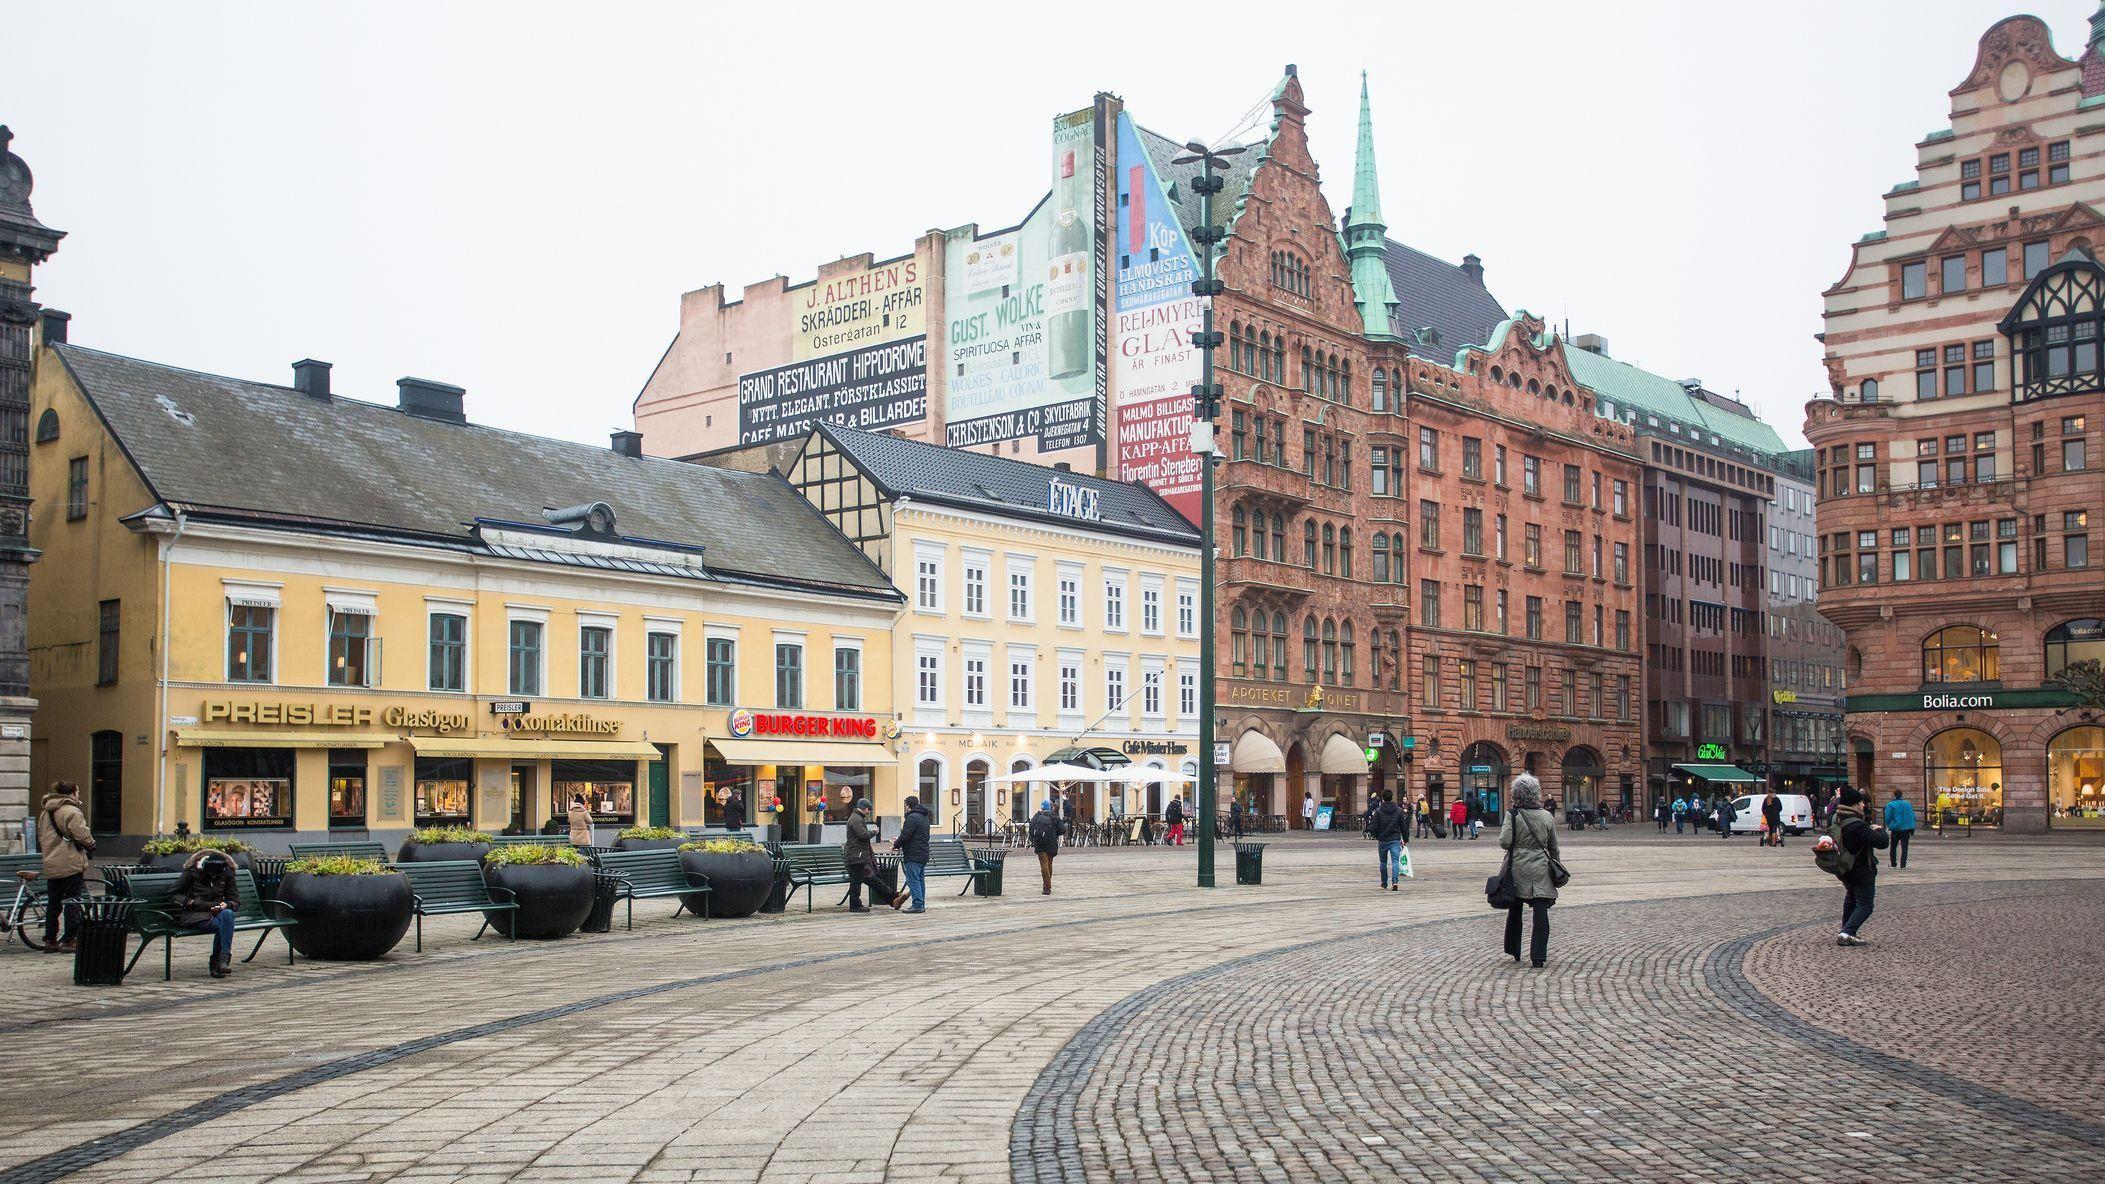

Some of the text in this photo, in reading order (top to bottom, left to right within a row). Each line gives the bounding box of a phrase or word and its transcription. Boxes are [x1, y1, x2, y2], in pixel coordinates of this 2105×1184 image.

[1055, 125, 1092, 145] COGNAC
[1150, 221, 1178, 249] KÖP
[801, 299, 871, 333] SKRÄDDERI
[882, 286, 922, 313] AFFÄR
[807, 288, 820, 308] J.
[952, 284, 1045, 345] GUST. WOLKE
[1120, 299, 1204, 333] REIJMYRE
[813, 315, 907, 349] Östergatan 12
[1096, 303, 1106, 357] GENOM
[1122, 323, 1201, 357] GLAS
[953, 340, 1010, 361] SPIRITUOSA
[1132, 350, 1191, 370] ÄR FINAST
[741, 374, 774, 405] GRAND
[777, 357, 848, 397] RESTAURANT
[952, 371, 993, 393] WOLKES
[1001, 361, 1044, 384] CALORIC
[1009, 378, 1047, 399] COGNAC
[1096, 361, 1106, 440] ANNONSERA
[1129, 384, 1166, 398] HAMNGATAN
[1172, 381, 1178, 391] 2
[752, 404, 779, 424] NYTT,
[781, 394, 831, 418] ELEGANT,
[1123, 403, 1153, 422] MALMÖ
[742, 424, 773, 444] CAFÉ
[849, 415, 857, 427] &
[946, 414, 1015, 448] CHRISTENSON
[1016, 415, 1025, 435] &
[1044, 400, 1091, 425] SKYLTFABRIK
[1083, 418, 1089, 432] 4
[1045, 435, 1087, 450] TELEFON 1307
[1122, 435, 1192, 460] KAPP-AFFÄ
[1121, 462, 1159, 482] Florentin
[1231, 686, 1291, 703] APOTEKET
[1923, 694, 1993, 708] Bolia.com
[203, 701, 470, 734] PREISLER Glasögon
[496, 703, 522, 712] PREISLER
[754, 714, 877, 738] BURGER KING
[1122, 740, 1141, 754] Café
